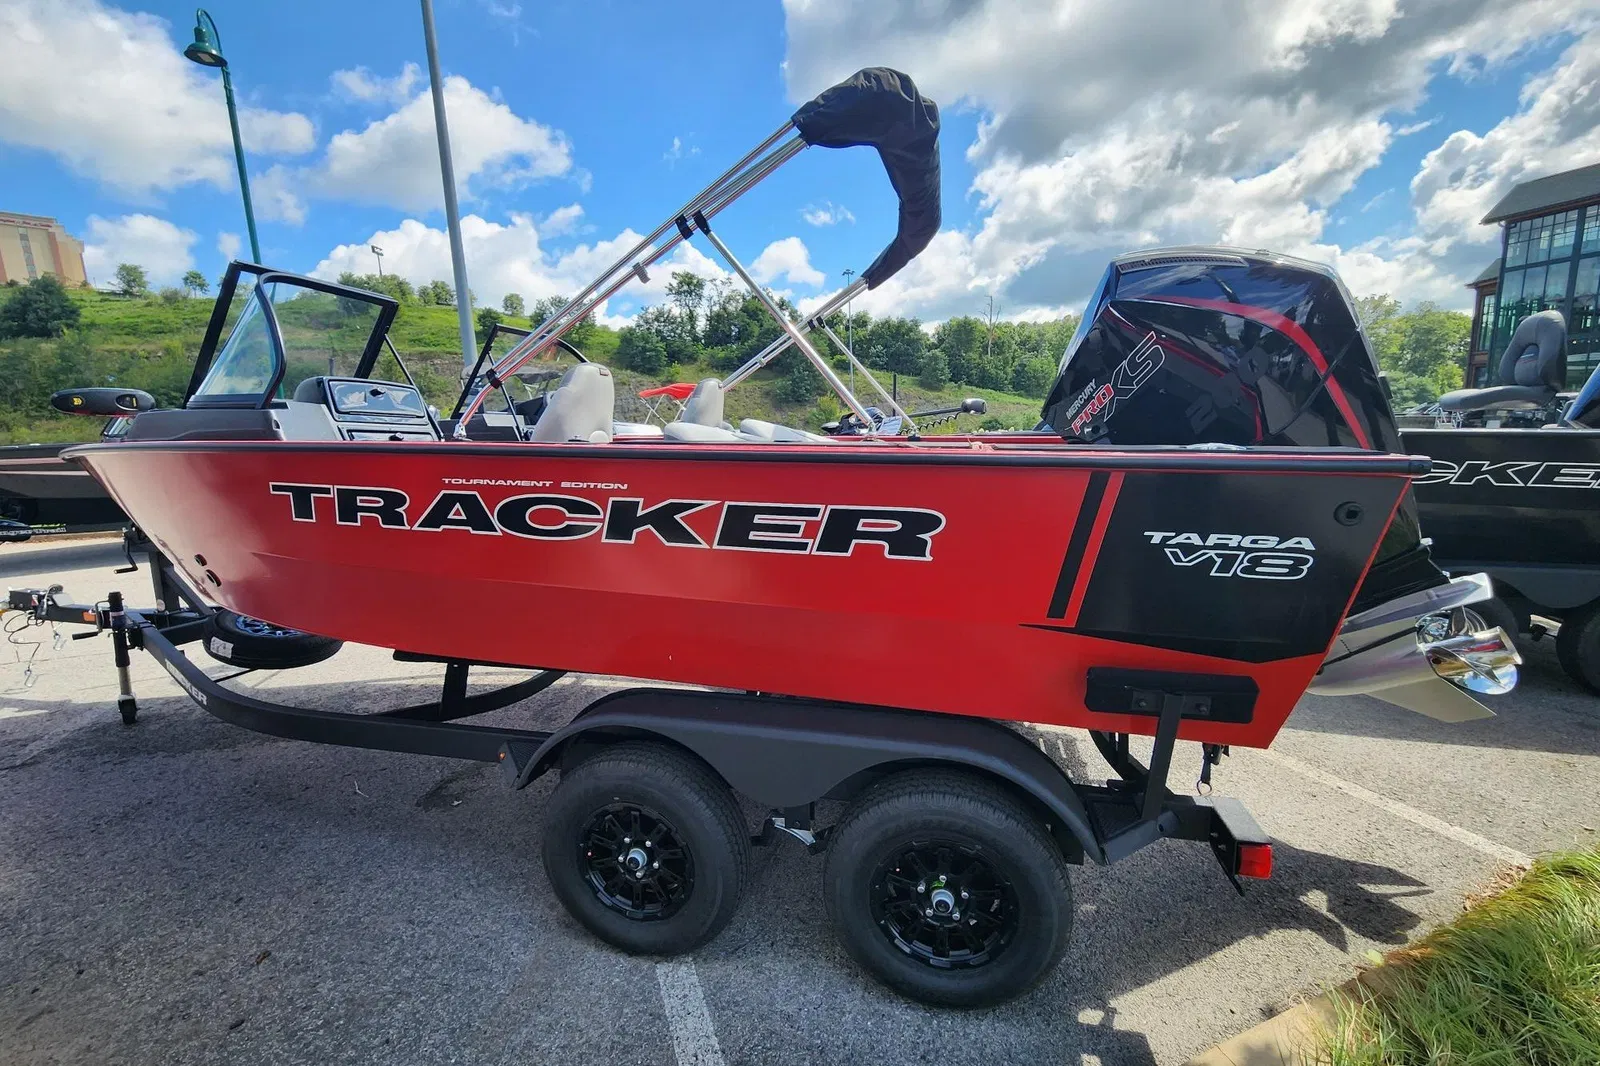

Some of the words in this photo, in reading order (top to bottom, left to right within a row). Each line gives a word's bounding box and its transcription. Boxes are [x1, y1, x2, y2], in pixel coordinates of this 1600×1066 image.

[1066, 378, 1097, 419] MERCURY
[1071, 382, 1115, 435] PRO
[1104, 331, 1166, 422] XS
[441, 477, 554, 488] TOURNAMENT
[560, 481, 628, 490] EDITION
[269, 482, 947, 561] TRACKER
[1143, 531, 1316, 551] TARGA
[1163, 548, 1314, 580] V18
